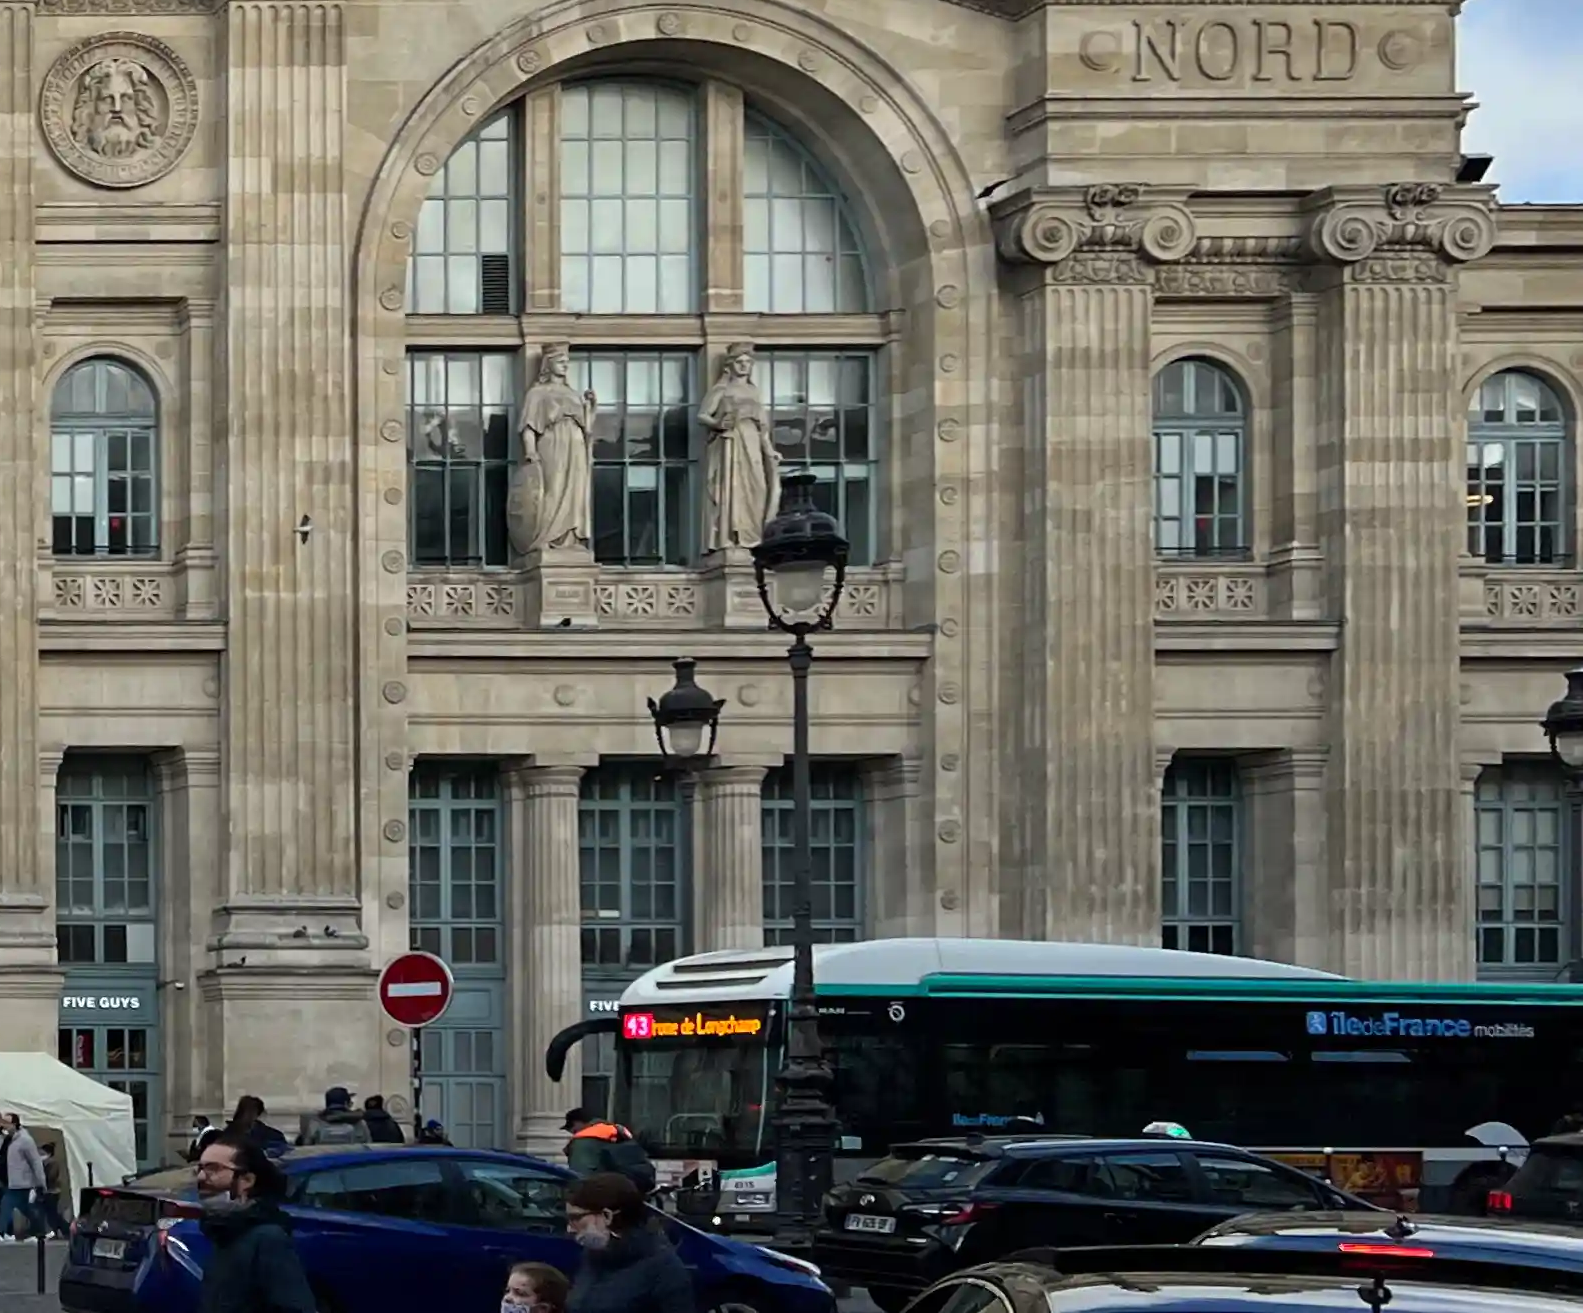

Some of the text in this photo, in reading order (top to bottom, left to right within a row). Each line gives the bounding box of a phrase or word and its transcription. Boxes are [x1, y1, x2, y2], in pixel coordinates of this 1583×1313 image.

[1131, 18, 1358, 82] NORD
[63, 996, 141, 1009] FIVE GUYS
[589, 1000, 620, 1012] FIVE
